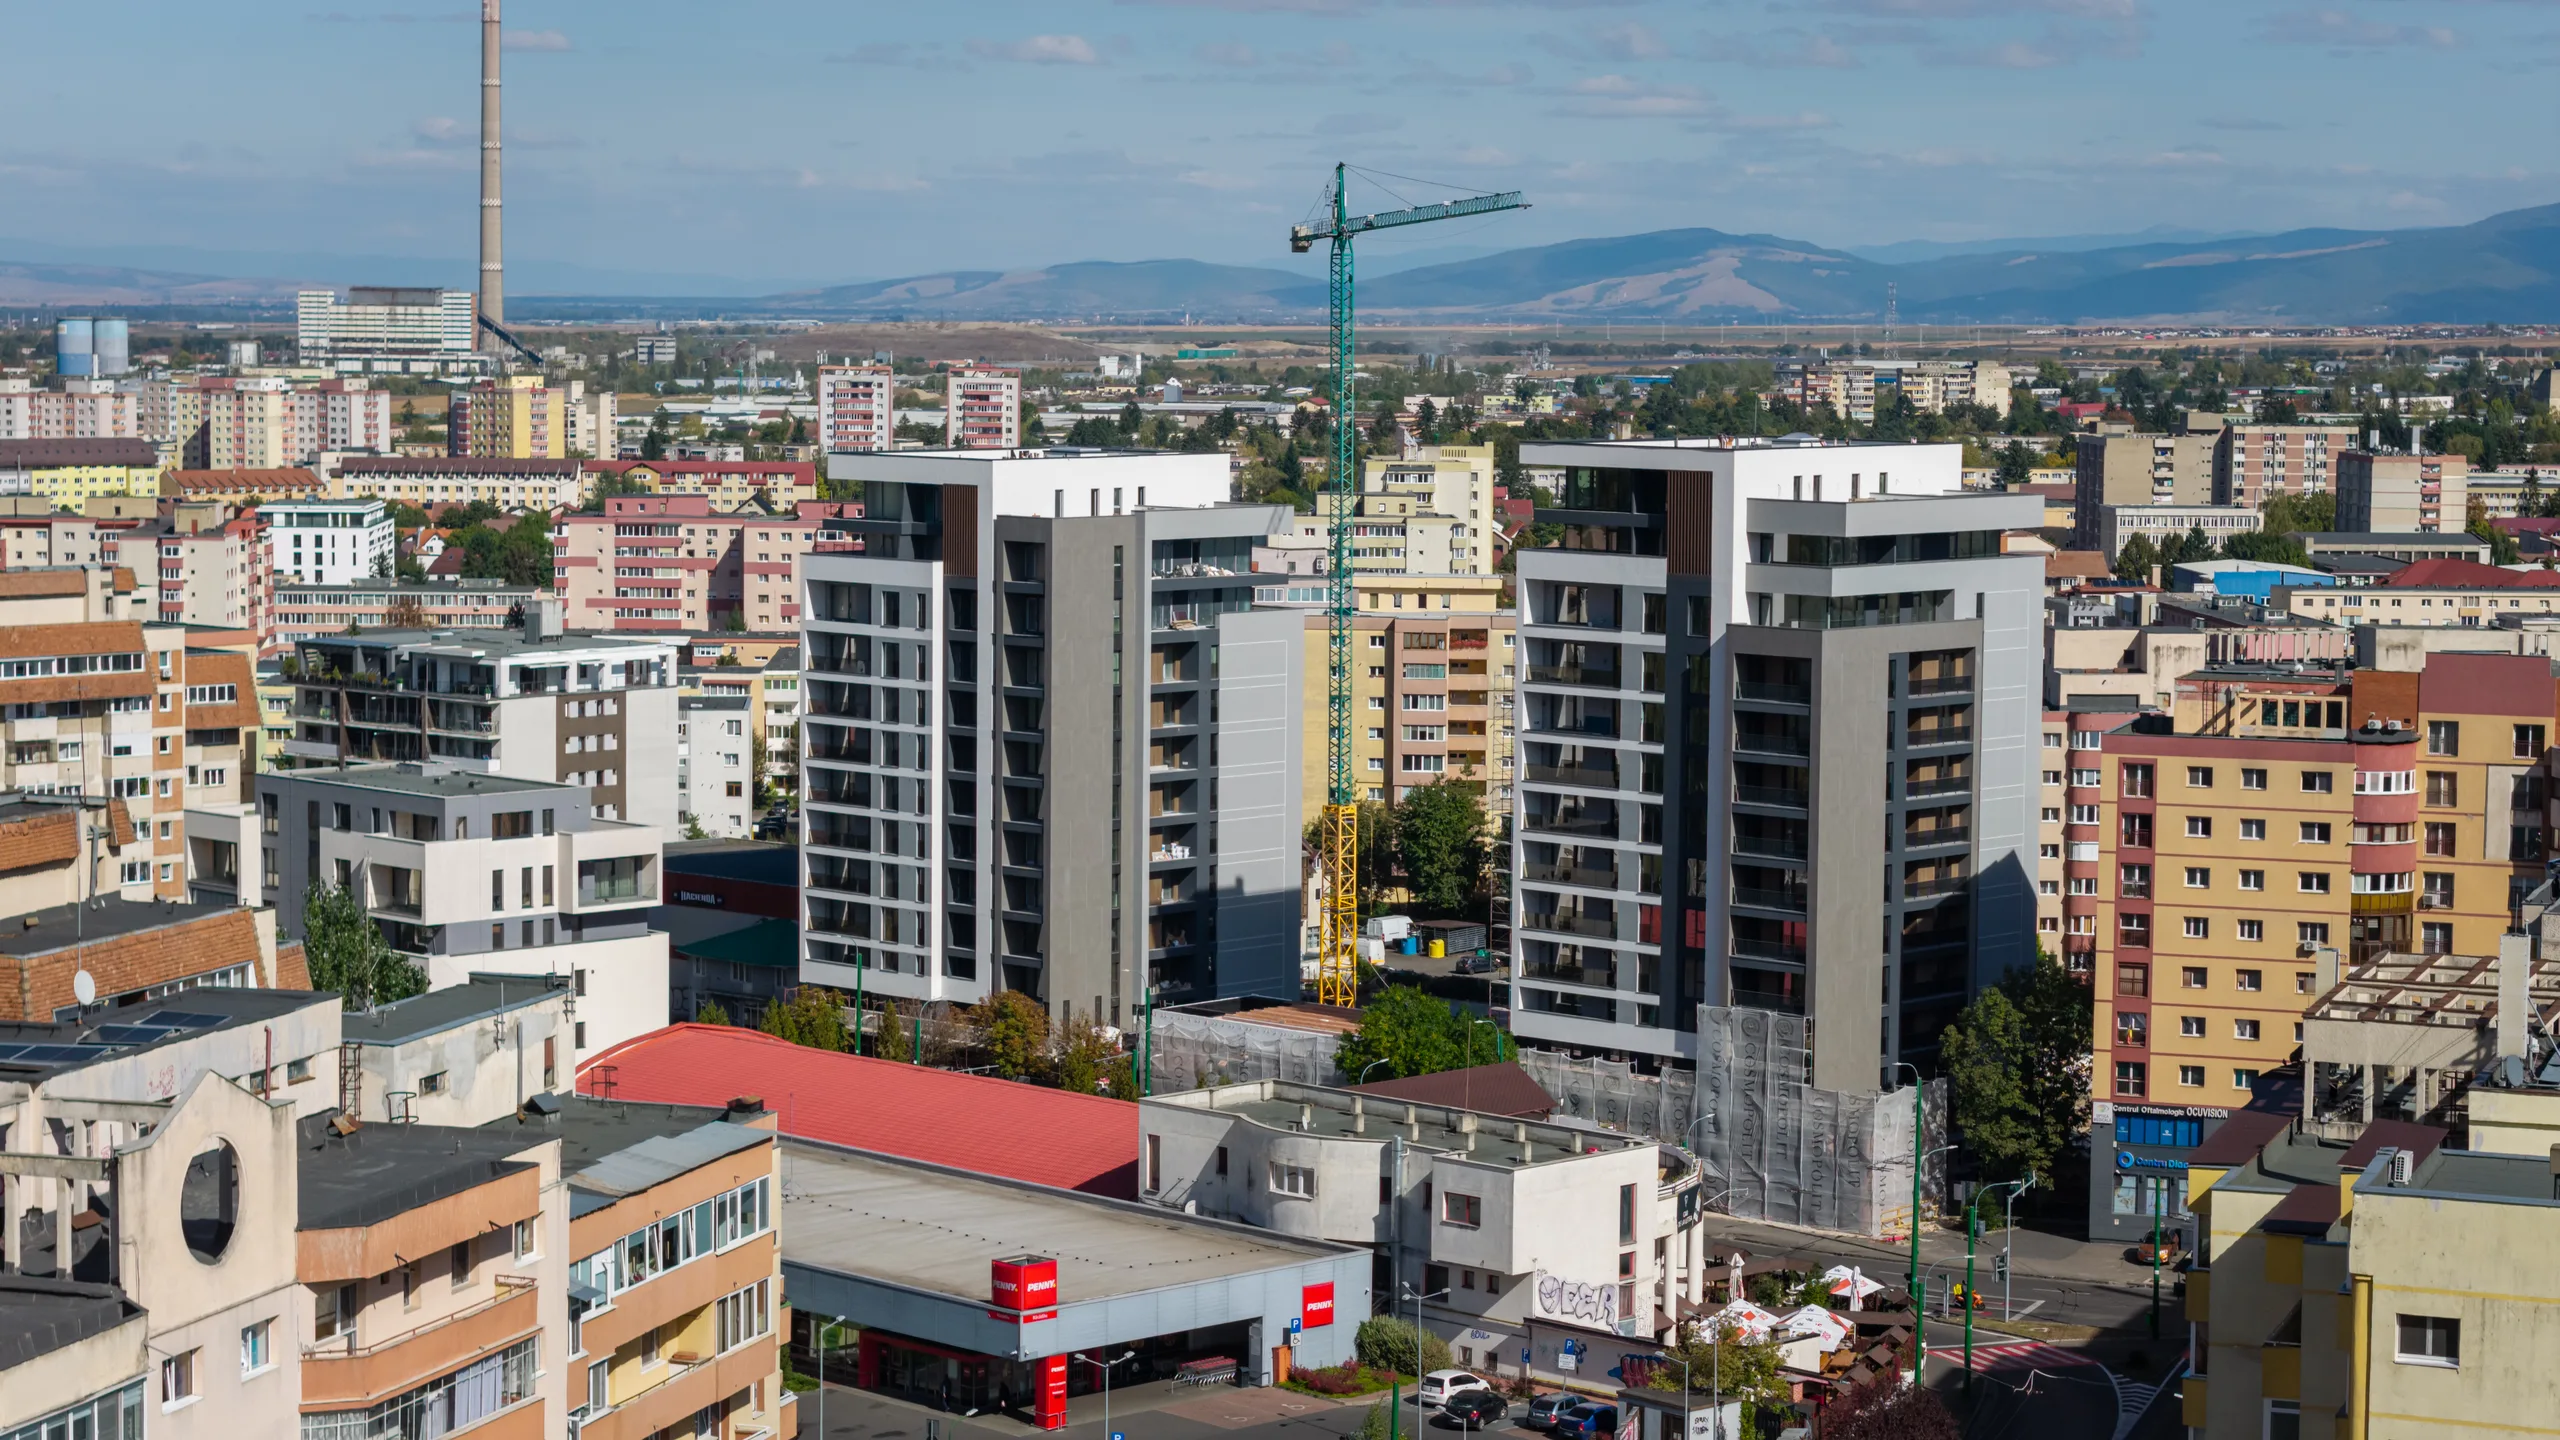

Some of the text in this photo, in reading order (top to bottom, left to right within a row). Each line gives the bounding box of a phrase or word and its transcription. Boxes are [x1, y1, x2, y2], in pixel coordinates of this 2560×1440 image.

[680, 890, 716, 905] HACIENDA
[1741, 1042, 1757, 1161] COSMOPOLIT
[2112, 1104, 2139, 1113] Centrul
[2186, 1106, 2228, 1119] OCUVISION
[1810, 1097, 1825, 1211] COSMOPOLIT
